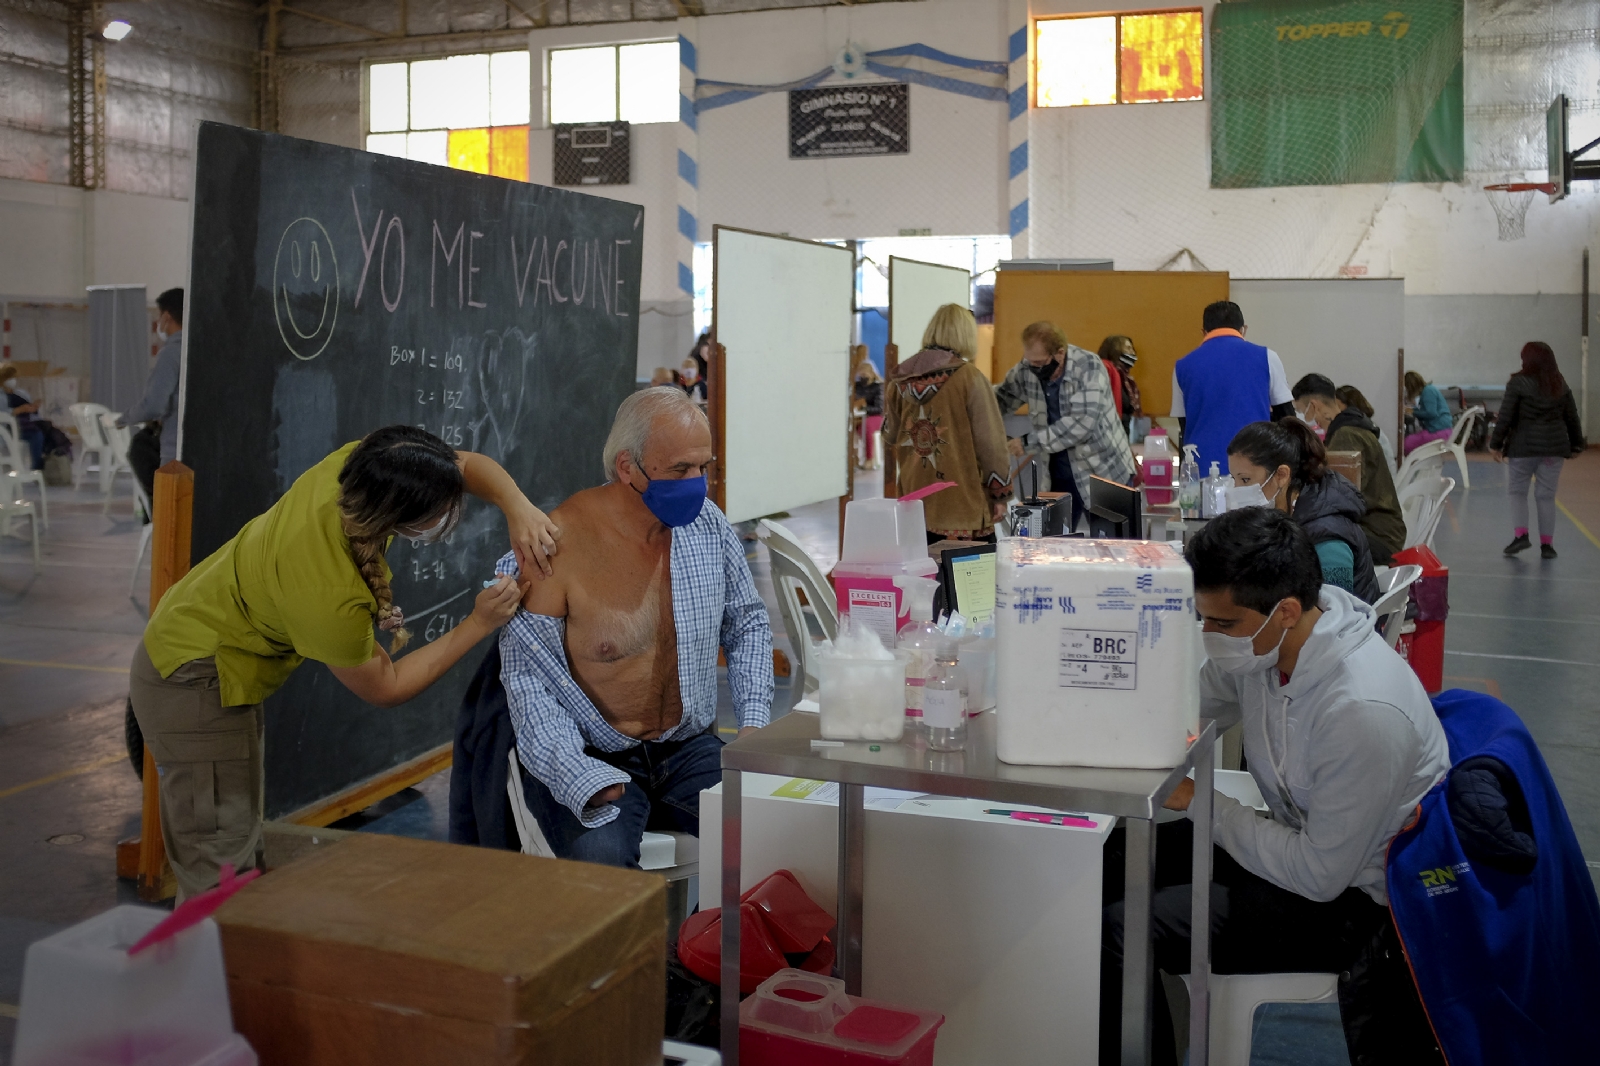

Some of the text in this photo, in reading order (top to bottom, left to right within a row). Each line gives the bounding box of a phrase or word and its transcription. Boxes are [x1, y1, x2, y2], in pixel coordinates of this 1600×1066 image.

[1275, 20, 1372, 42] TOPPER
[800, 91, 868, 113] GIMNASIO
[889, 97, 897, 109] 1
[352, 187, 643, 317] YO ME VACUNÉ
[416, 389, 427, 405] 2
[443, 388, 465, 410] 132
[441, 425, 463, 446] 125
[851, 592, 892, 601] EXCELENT
[1093, 637, 1127, 655] BRC
[1418, 865, 1457, 888] RN
